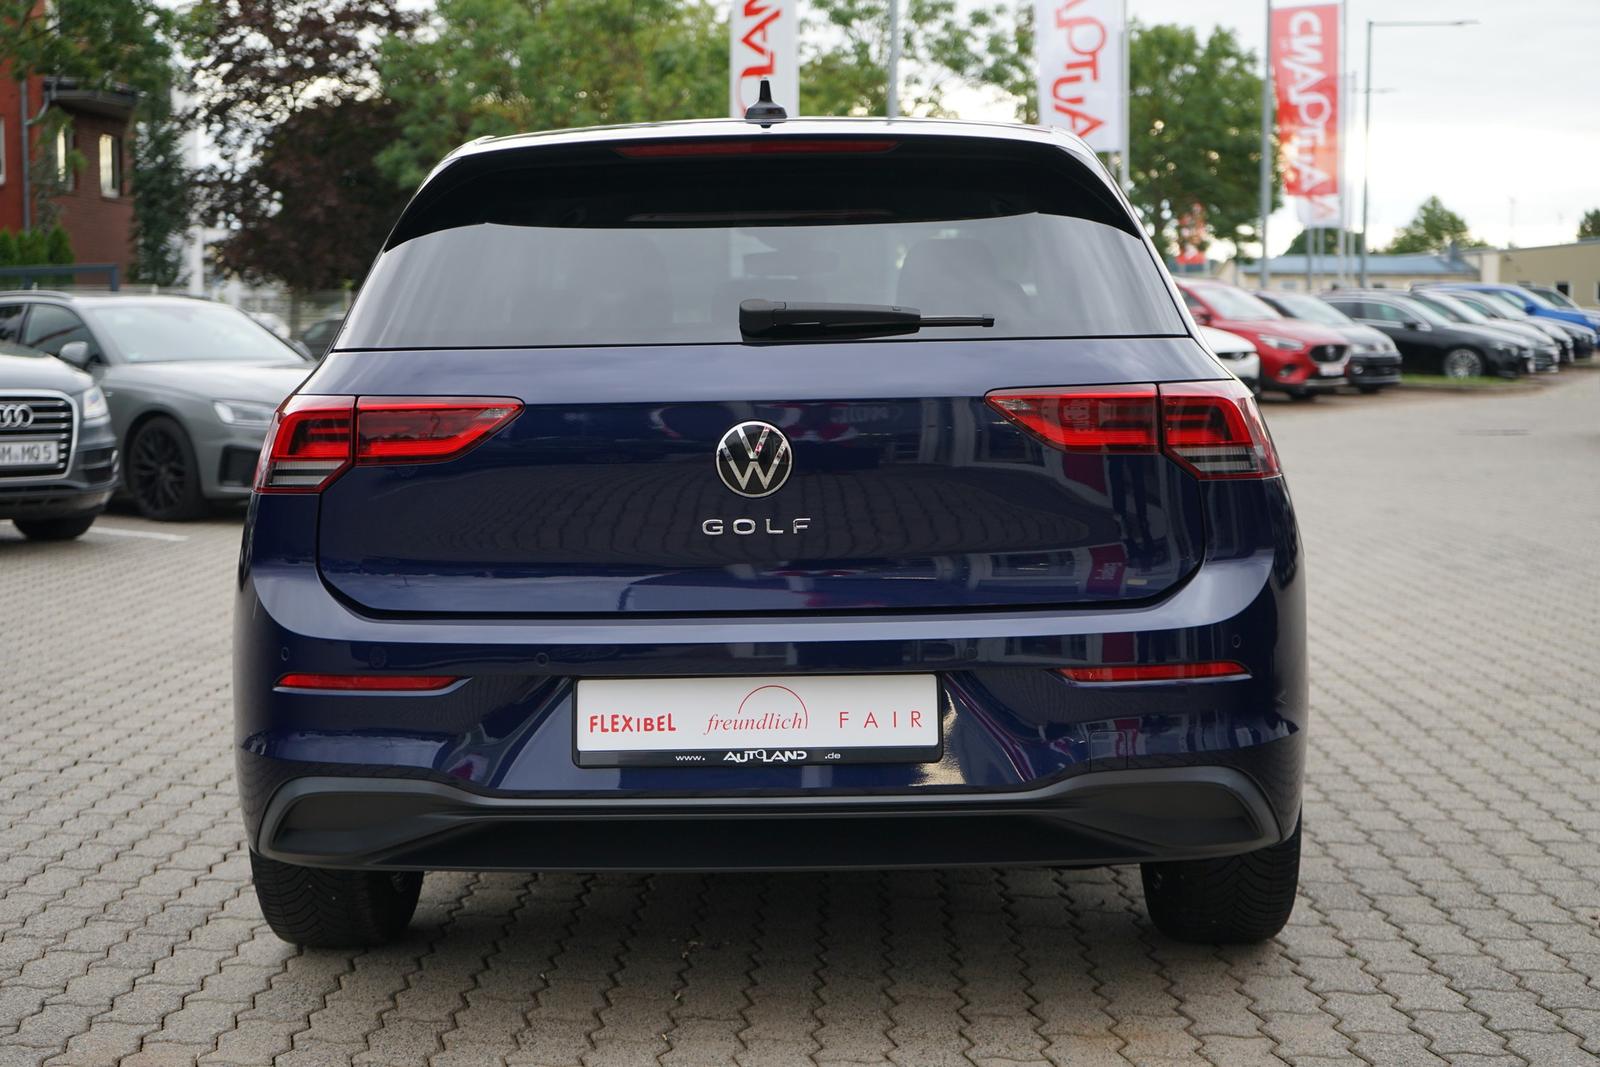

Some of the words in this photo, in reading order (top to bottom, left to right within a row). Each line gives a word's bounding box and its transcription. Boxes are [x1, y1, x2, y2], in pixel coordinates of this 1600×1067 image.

[702, 517, 811, 535] GOLF
[703, 711, 804, 736] freundlich
[839, 710, 922, 728] FAIR
[723, 749, 807, 763] AUTOLAND
